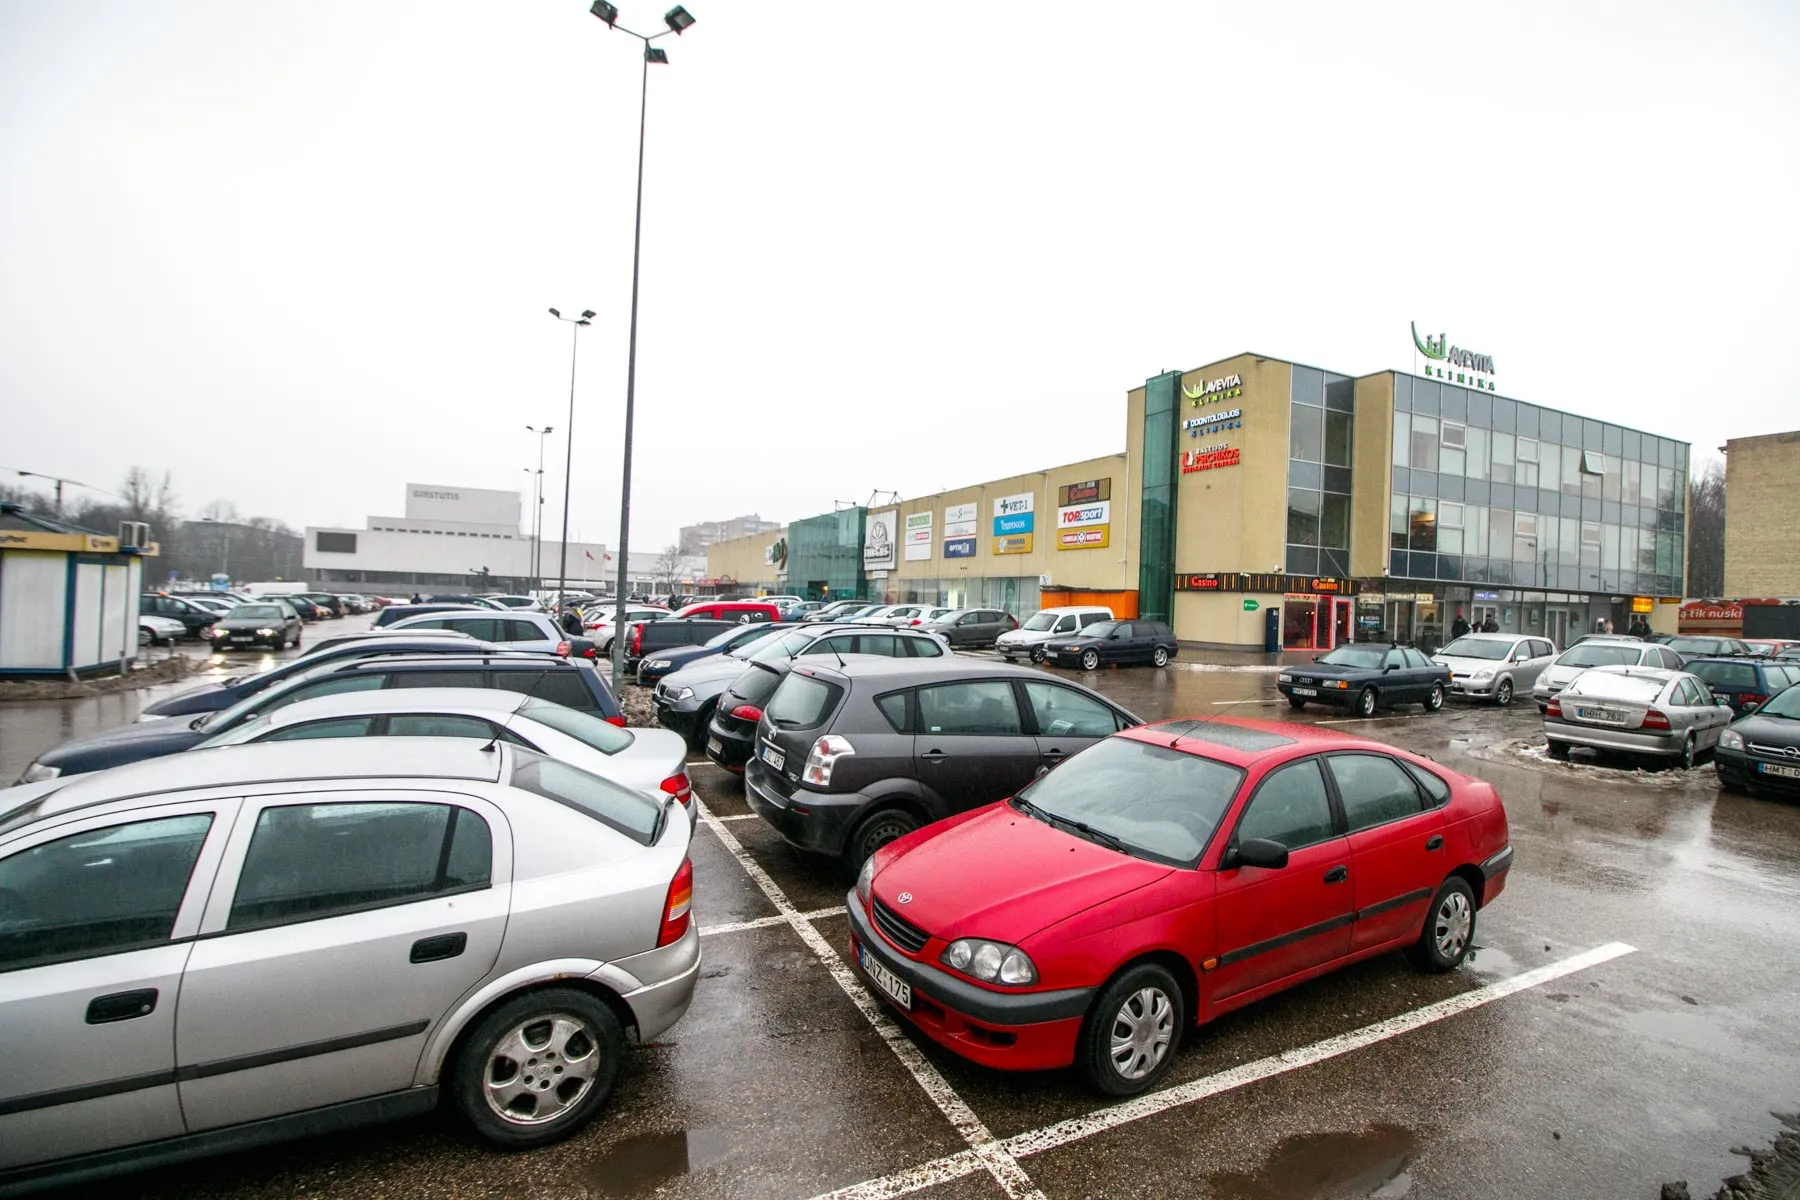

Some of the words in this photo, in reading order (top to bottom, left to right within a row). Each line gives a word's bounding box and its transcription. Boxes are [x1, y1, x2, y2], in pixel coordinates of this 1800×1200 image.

[1447, 344, 1495, 375] AVEVITA
[1205, 373, 1242, 394] AVEVITA
[1425, 364, 1495, 392] KLINIKA
[1191, 388, 1242, 408] KLINIKA
[1191, 576, 1218, 588] Casino
[1690, 610, 1705, 618] tik
[1765, 764, 1786, 775] HMT
[864, 951, 882, 984] DNZ
[889, 975, 909, 1005] 175
